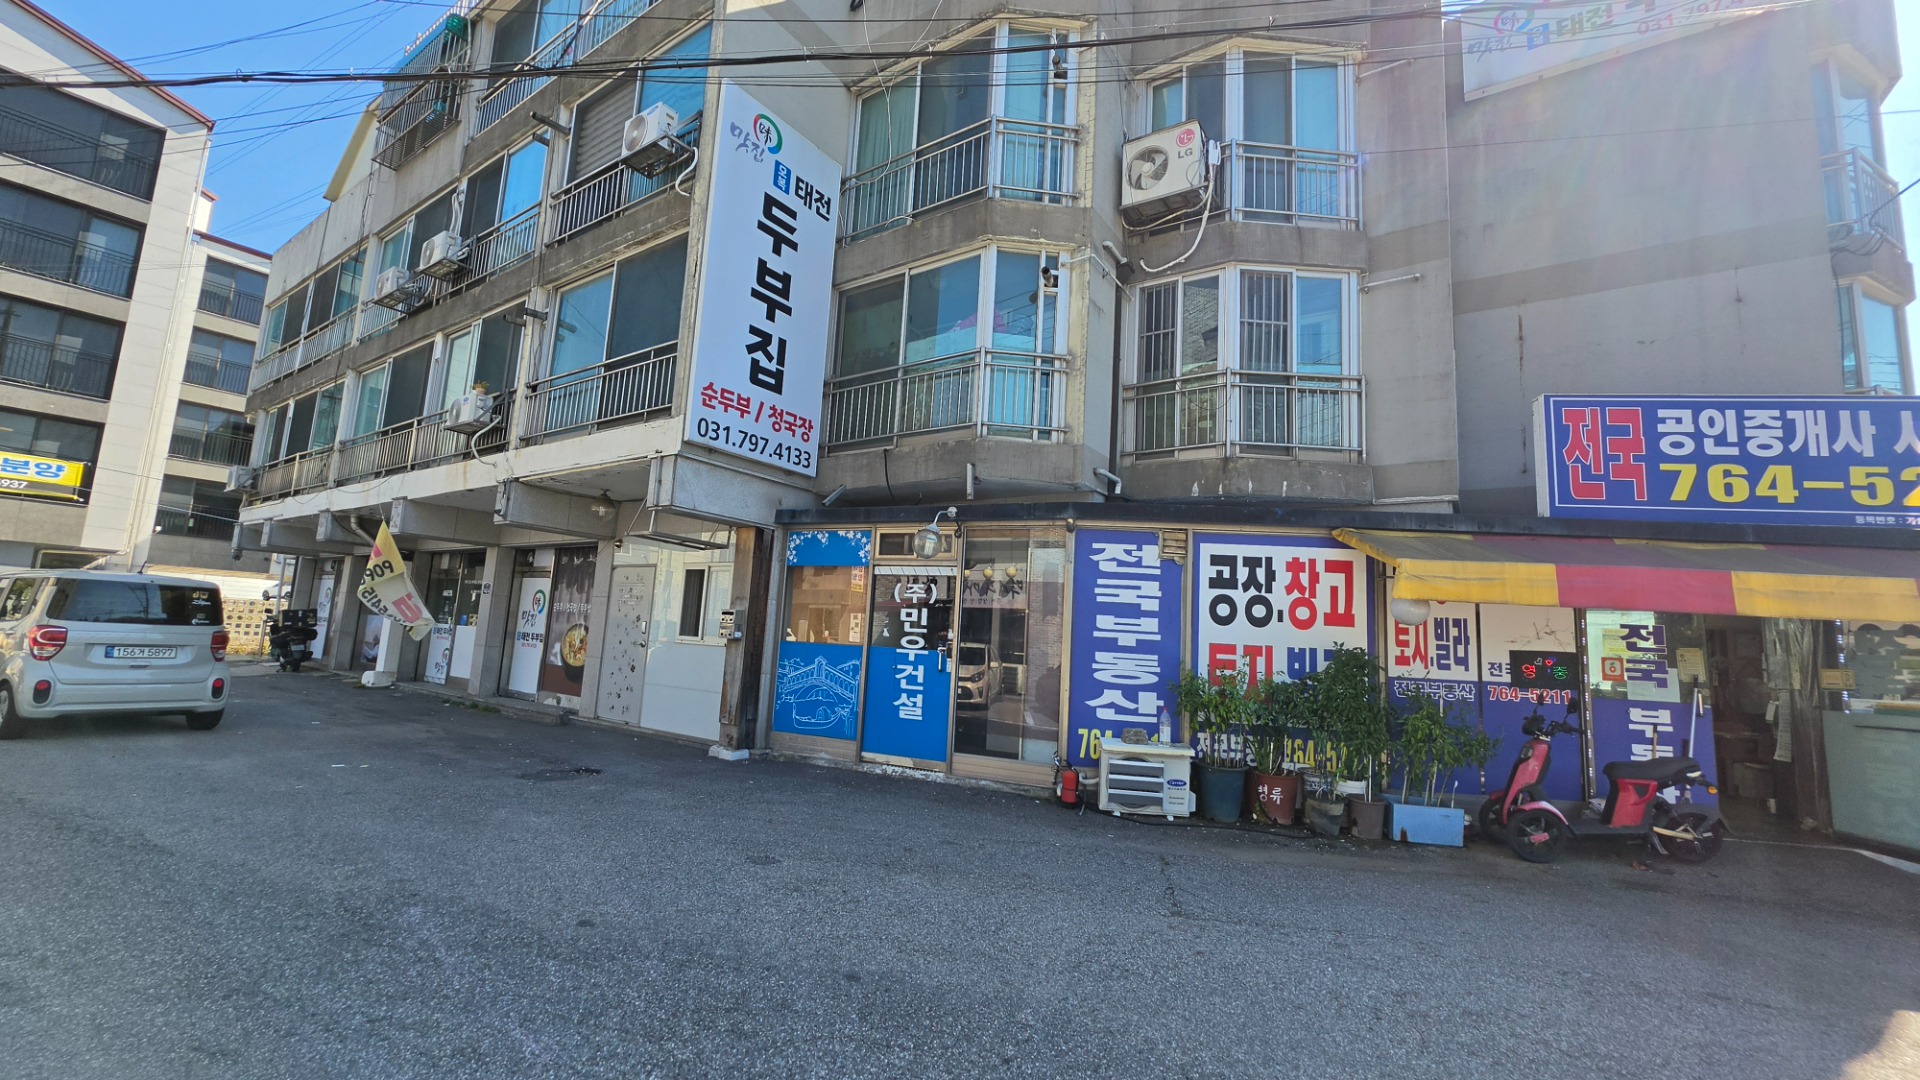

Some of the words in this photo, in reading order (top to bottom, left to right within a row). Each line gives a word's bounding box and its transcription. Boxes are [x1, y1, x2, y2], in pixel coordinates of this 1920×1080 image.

[730, 121, 764, 163] 맛집
[1177, 148, 1192, 159] LG
[795, 175, 831, 222] 태전
[745, 191, 798, 395] 두부집
[701, 381, 751, 419] 순두부
[768, 404, 813, 443] 청국장
[1657, 408, 1876, 457] 공인중개사
[697, 417, 812, 469] 031.797.4133
[1562, 407, 1647, 500] 전국
[0, 457, 66, 479] 분양
[0, 479, 28, 489] 937
[147, 648, 174, 657] 5897
[1084, 543, 1164, 723] 전국부동산
[1487, 685, 1572, 705] 764-5211
